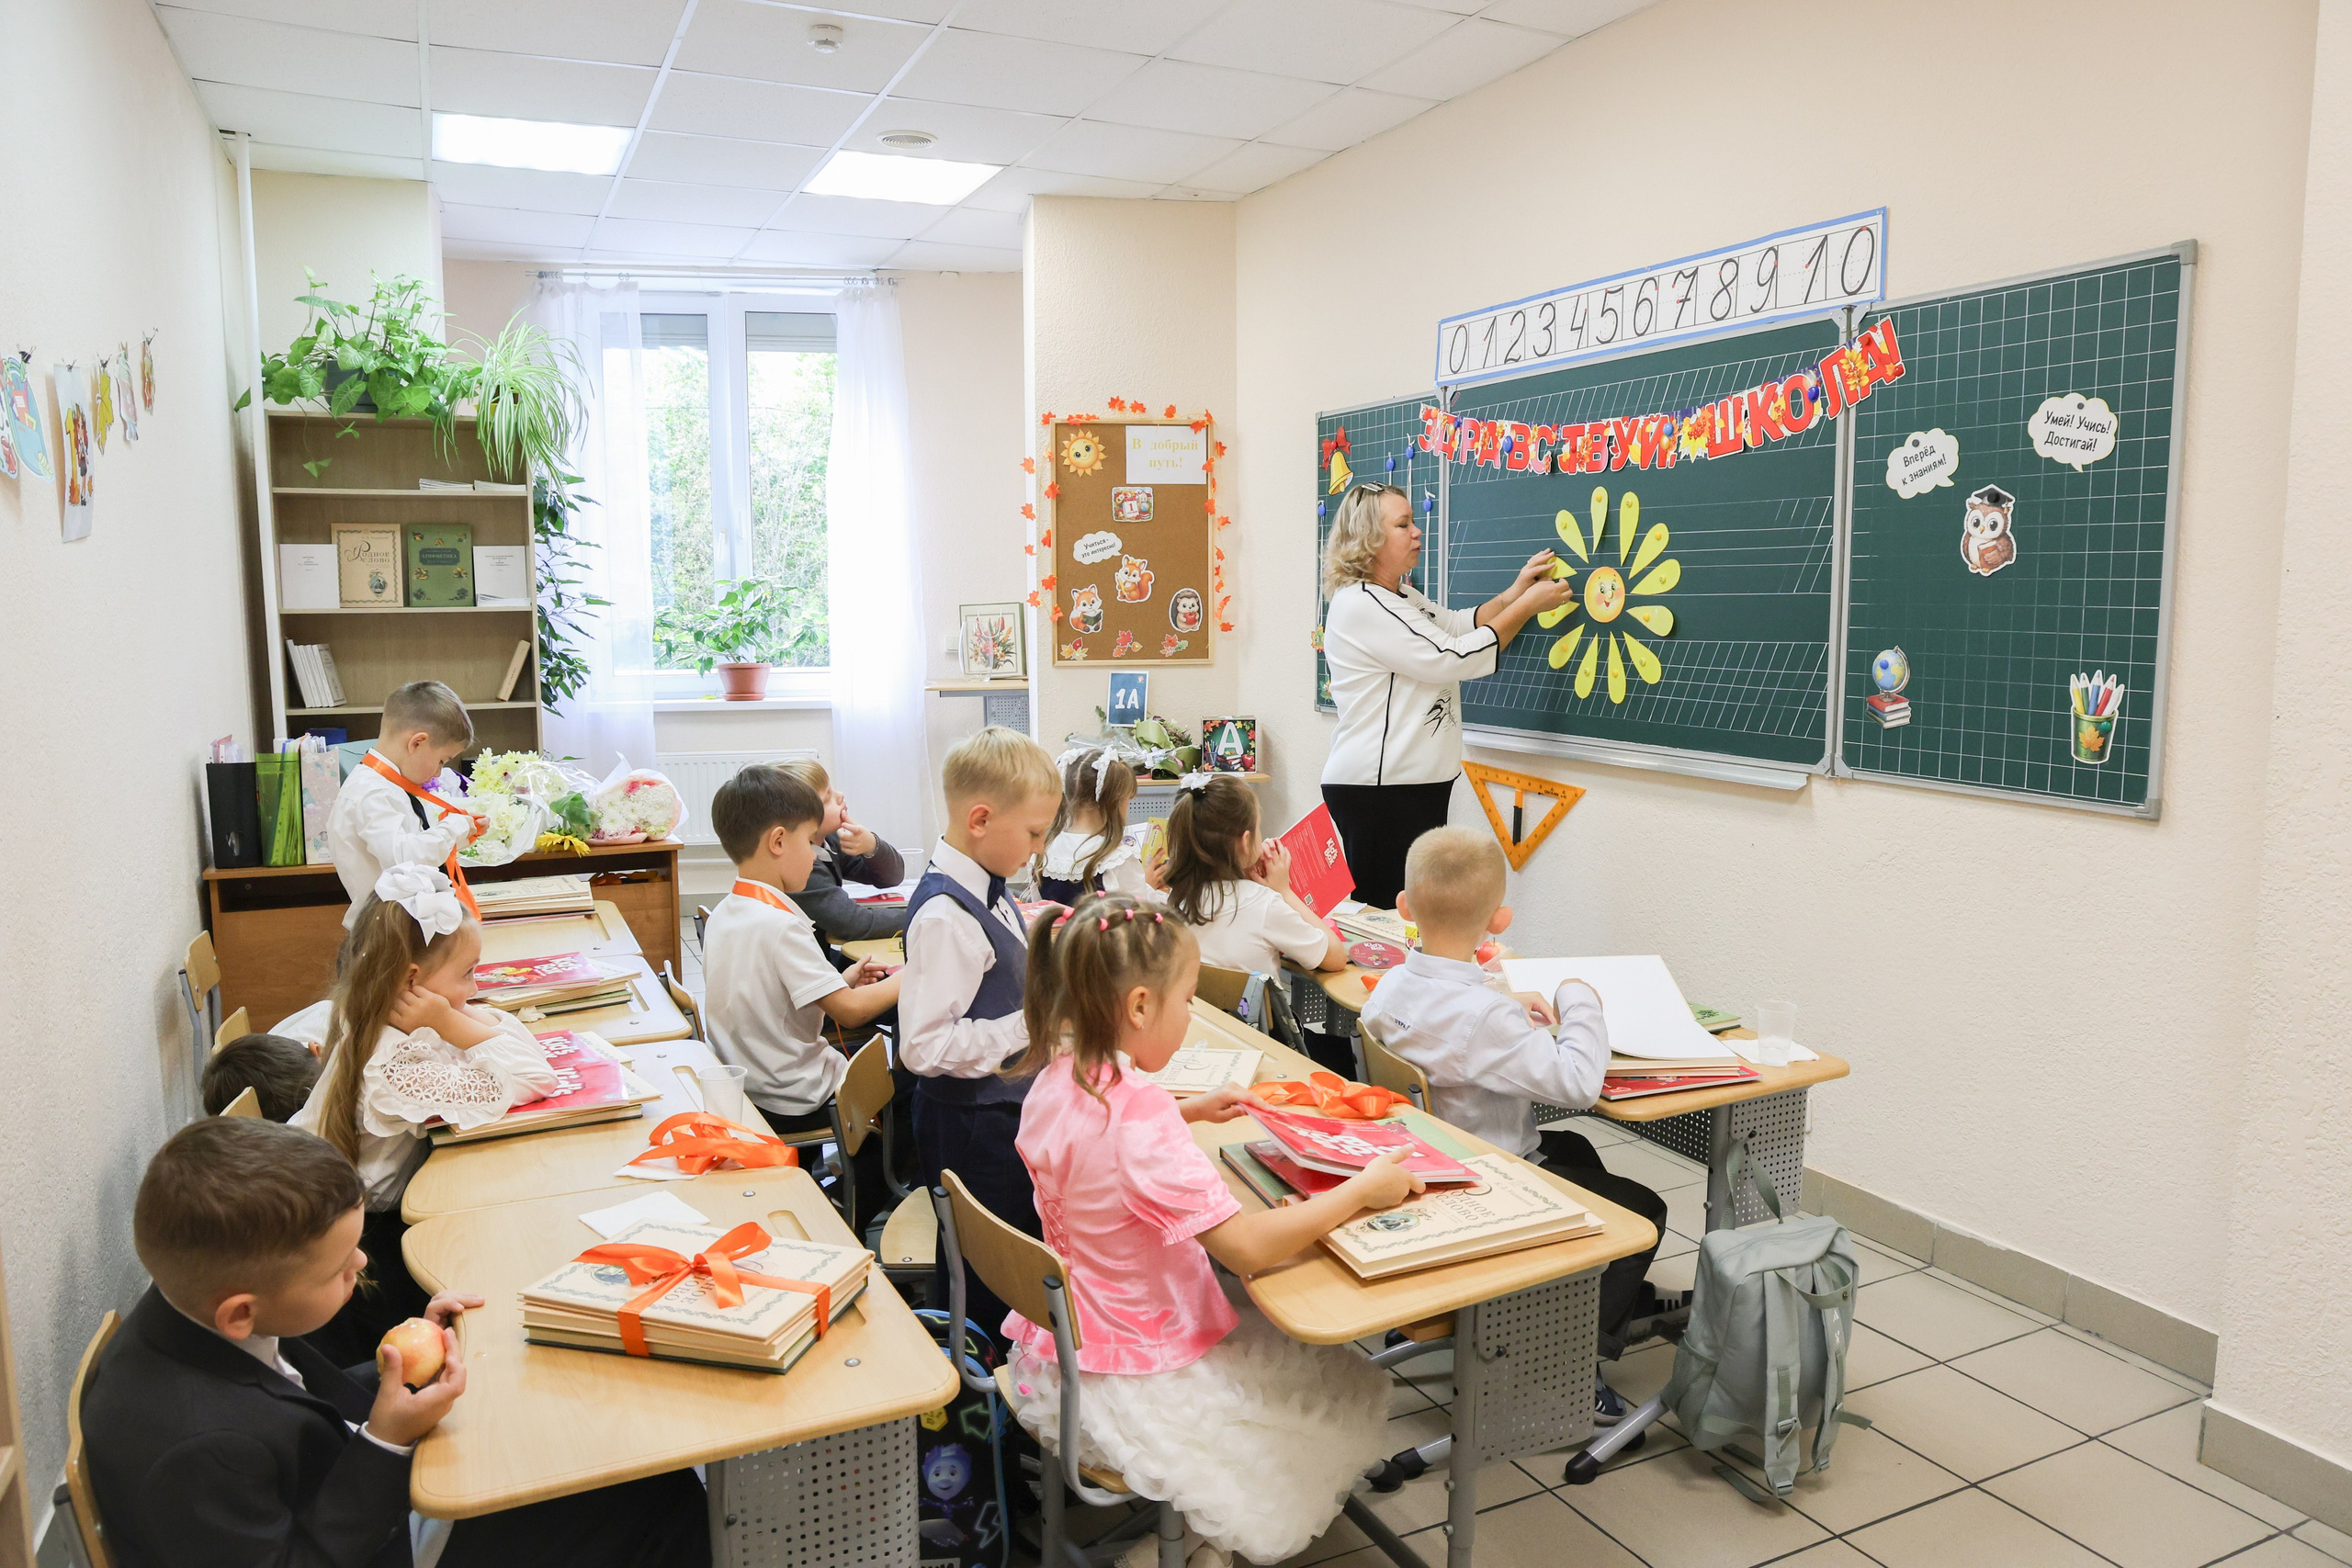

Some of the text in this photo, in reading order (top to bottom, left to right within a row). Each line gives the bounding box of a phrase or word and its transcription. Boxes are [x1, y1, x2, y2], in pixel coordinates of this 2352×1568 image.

[1449, 226, 1875, 374] 0 1 2 3 4 5 6 7 8 9 10
[1706, 315, 1905, 458] ШКОЛА!
[2044, 411, 2111, 434] Умей! Учись!
[1132, 438, 1198, 453] В добрый
[2044, 431, 2098, 451] Достигай!
[1149, 457, 1182, 470] путь!
[1903, 446, 1936, 468] Вперёд
[1902, 454, 1947, 486] к знаниям!
[1324, 847, 1335, 865] Box
[1326, 837, 1339, 860] Kid's
